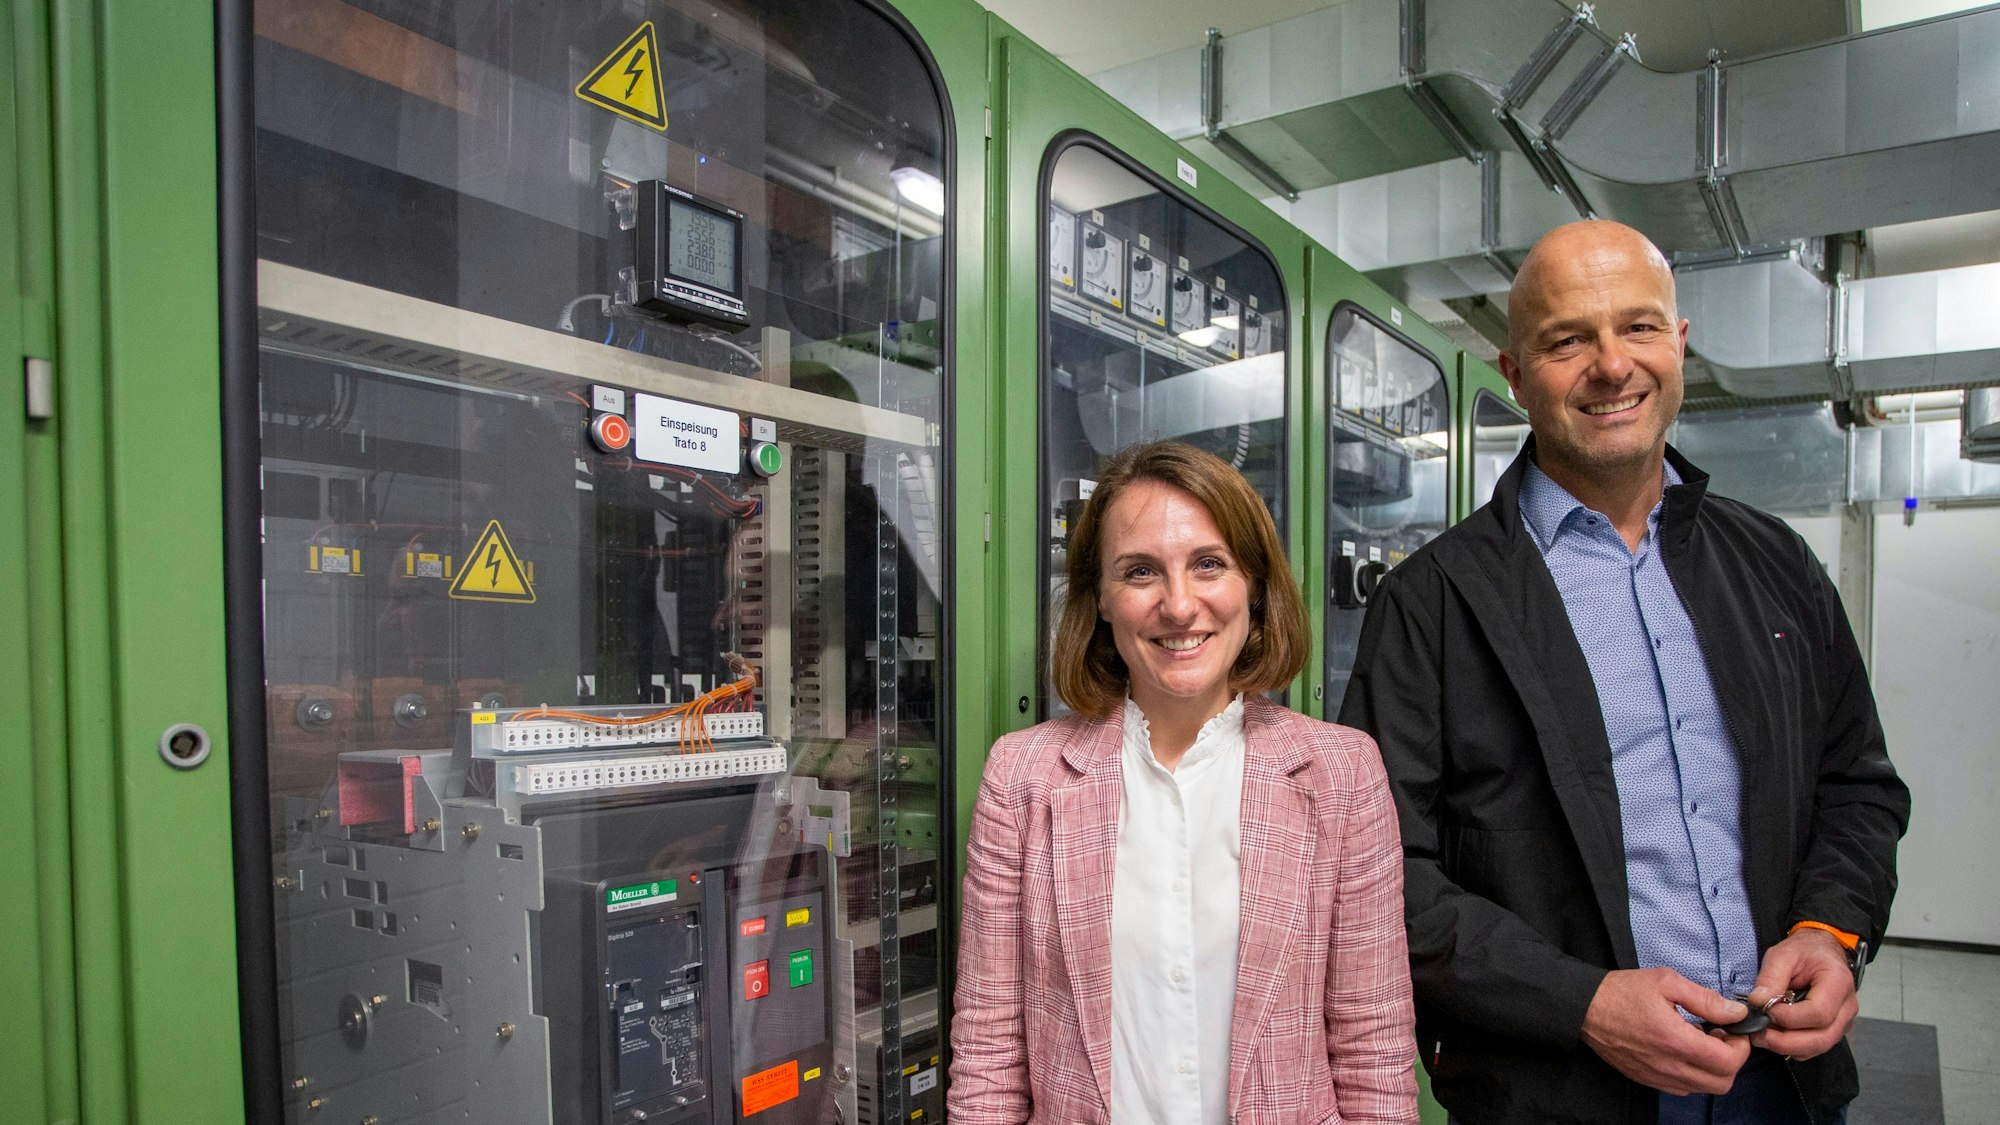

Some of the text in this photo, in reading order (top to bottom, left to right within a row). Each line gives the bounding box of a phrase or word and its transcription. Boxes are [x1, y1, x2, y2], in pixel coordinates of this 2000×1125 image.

[603, 394, 616, 405] Aus
[660, 416, 718, 438] Einspeisung
[760, 426, 768, 434] Ein
[673, 436, 707, 452] Trafo 8
[611, 889, 648, 902] MOELLER
